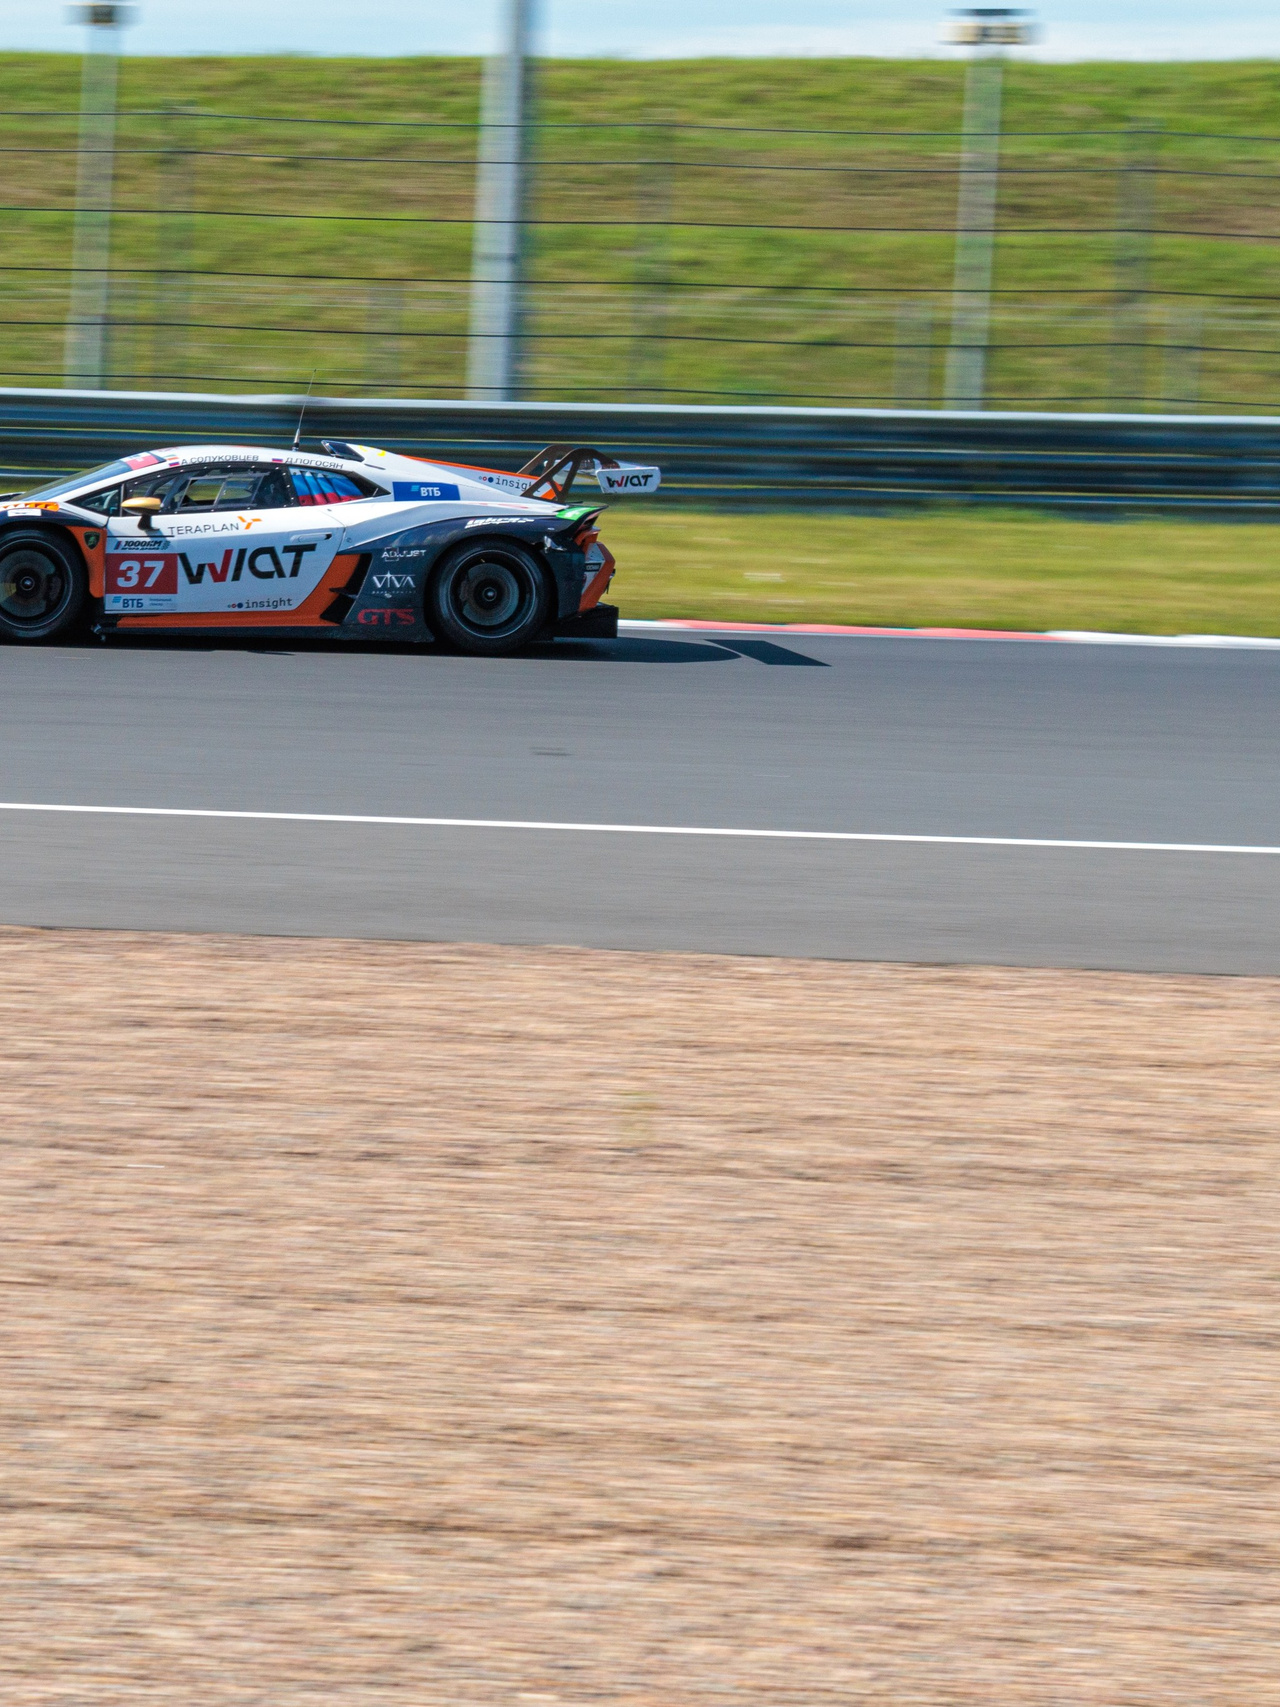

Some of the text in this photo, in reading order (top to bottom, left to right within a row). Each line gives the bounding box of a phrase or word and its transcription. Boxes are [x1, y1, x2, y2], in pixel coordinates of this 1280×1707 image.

[495, 476, 540, 492] insig
[420, 487, 441, 497] ВТБ
[168, 523, 239, 535] TERAPLAN
[117, 560, 165, 588] 37
[373, 572, 416, 588] VIVA
[122, 598, 144, 608] ВТБ
[245, 598, 292, 611] insight
